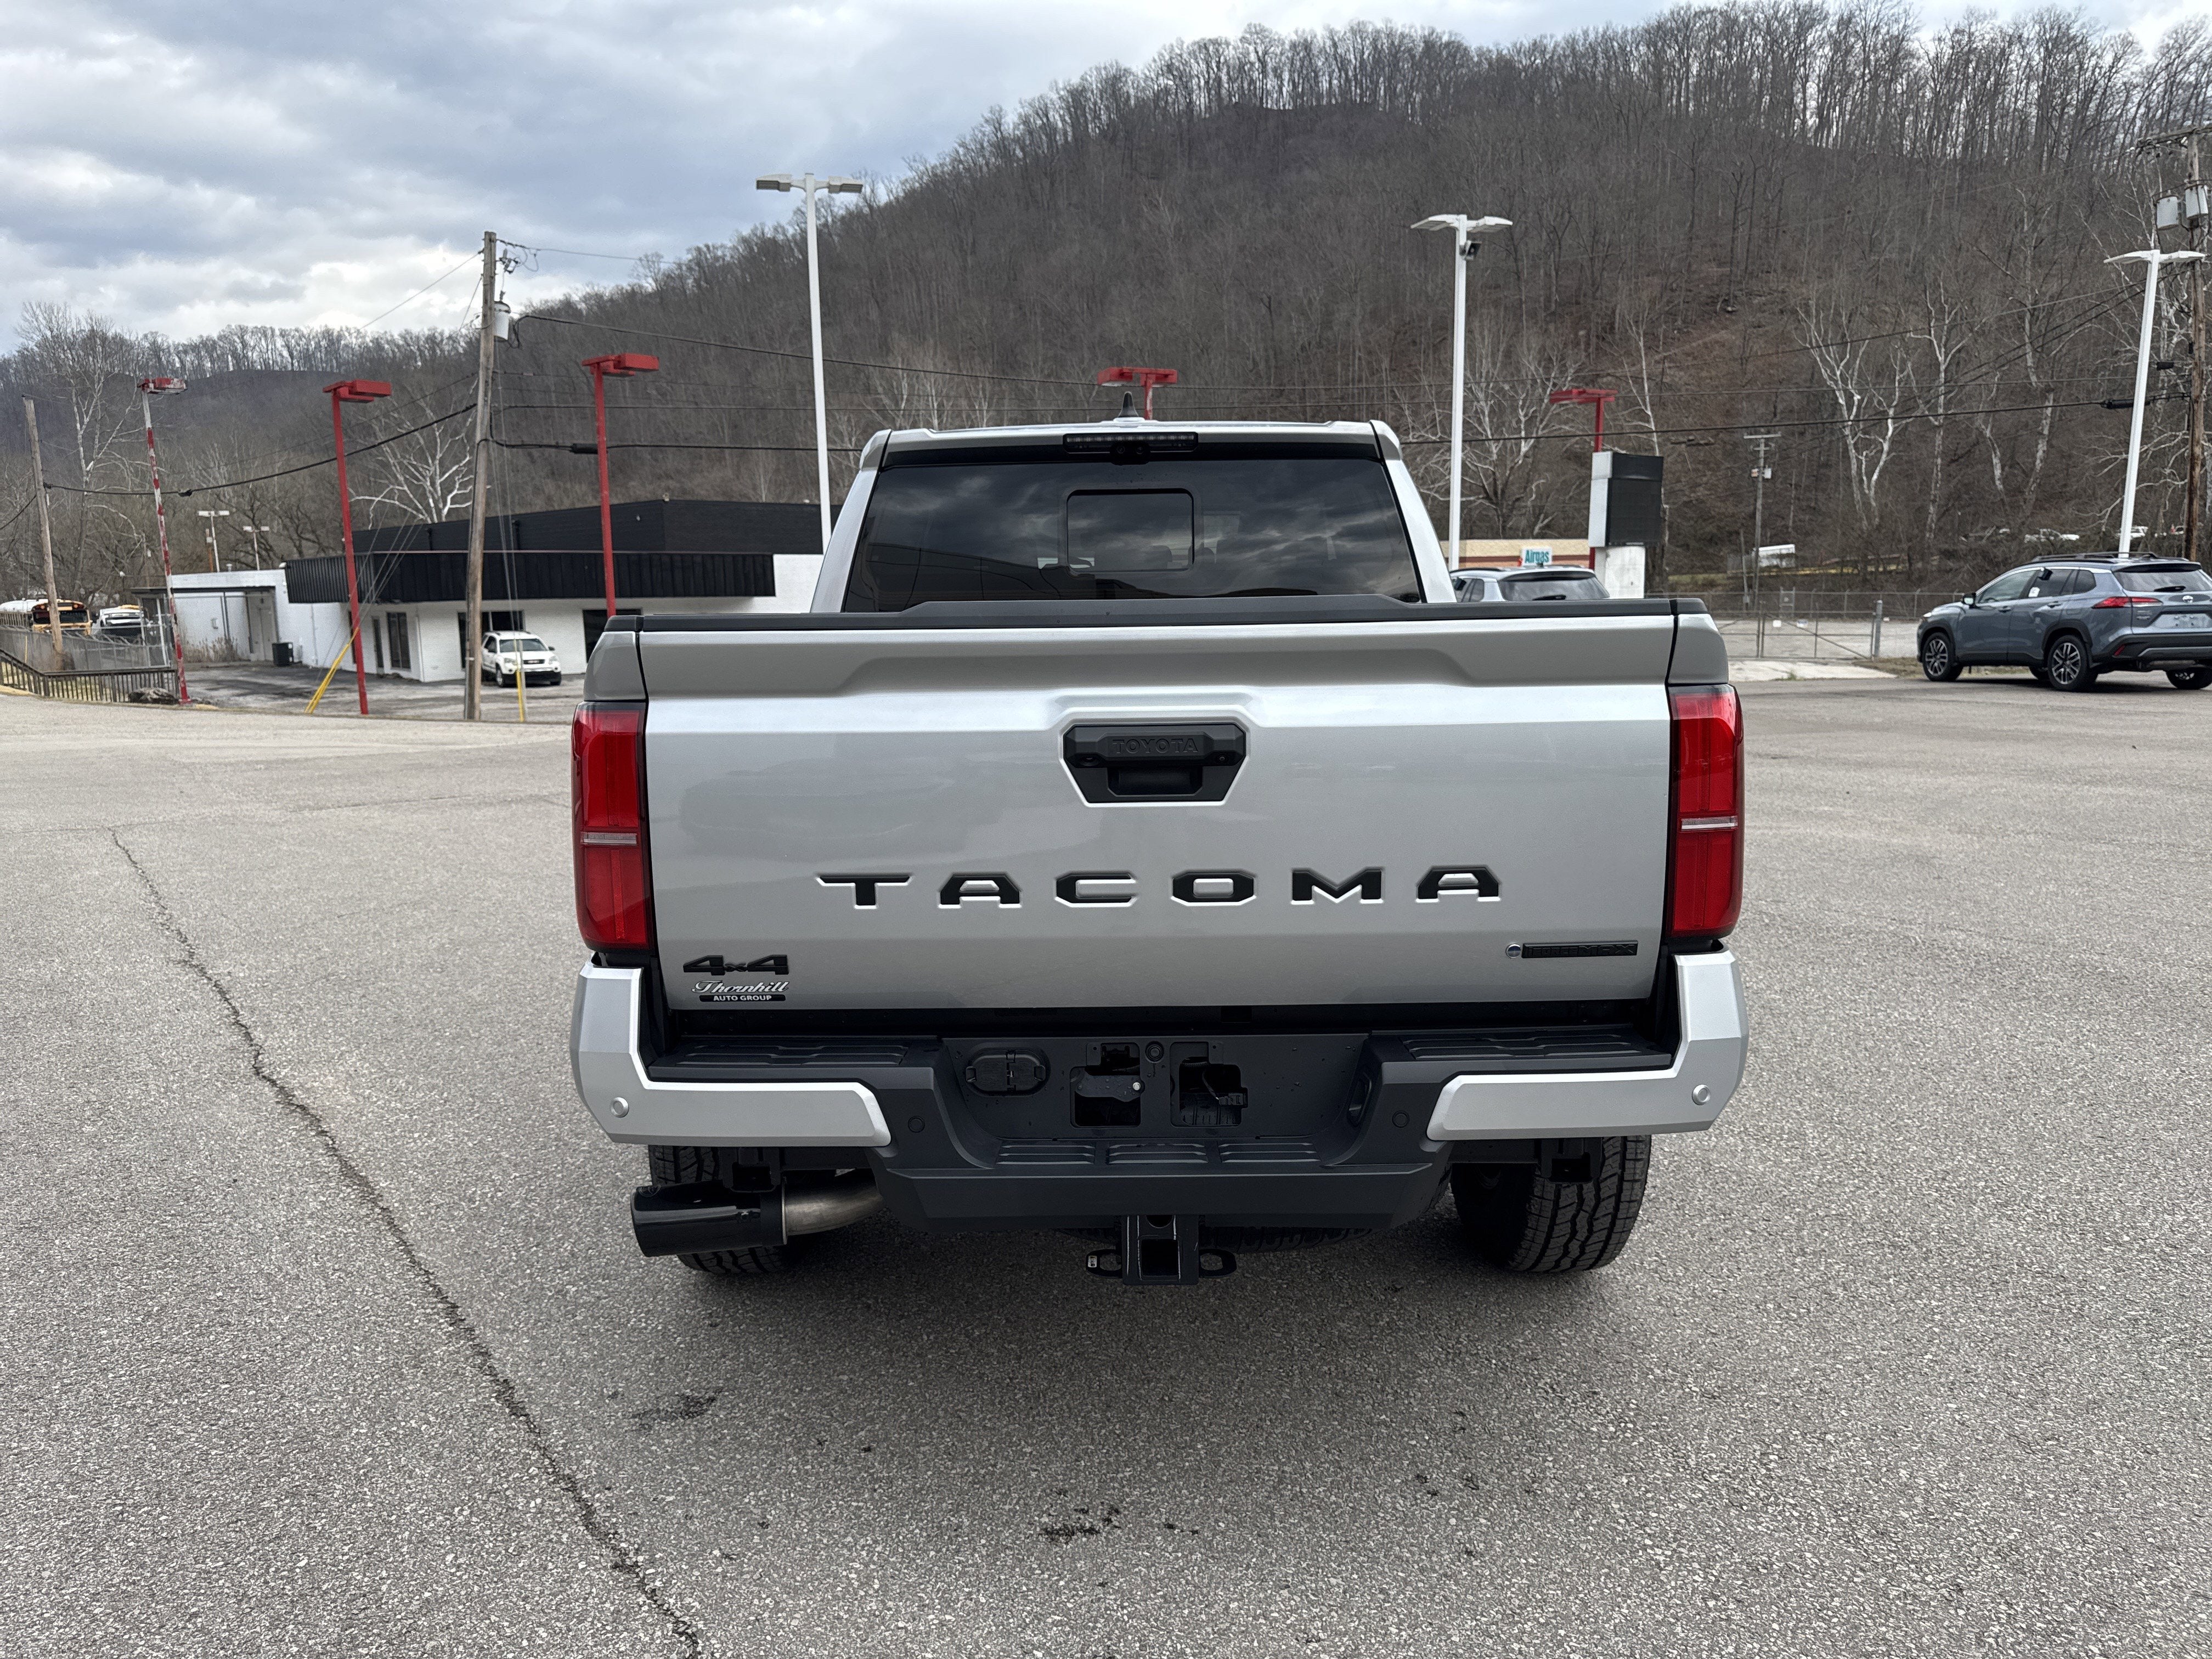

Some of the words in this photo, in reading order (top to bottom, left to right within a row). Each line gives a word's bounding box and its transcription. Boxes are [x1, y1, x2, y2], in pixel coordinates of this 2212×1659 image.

[1525, 550, 1549, 563] Airgas
[1113, 738, 1198, 754] TOYOTA
[816, 866, 1502, 909] TACOMA
[683, 955, 789, 975] 4x4
[691, 980, 789, 993] Thornhill
